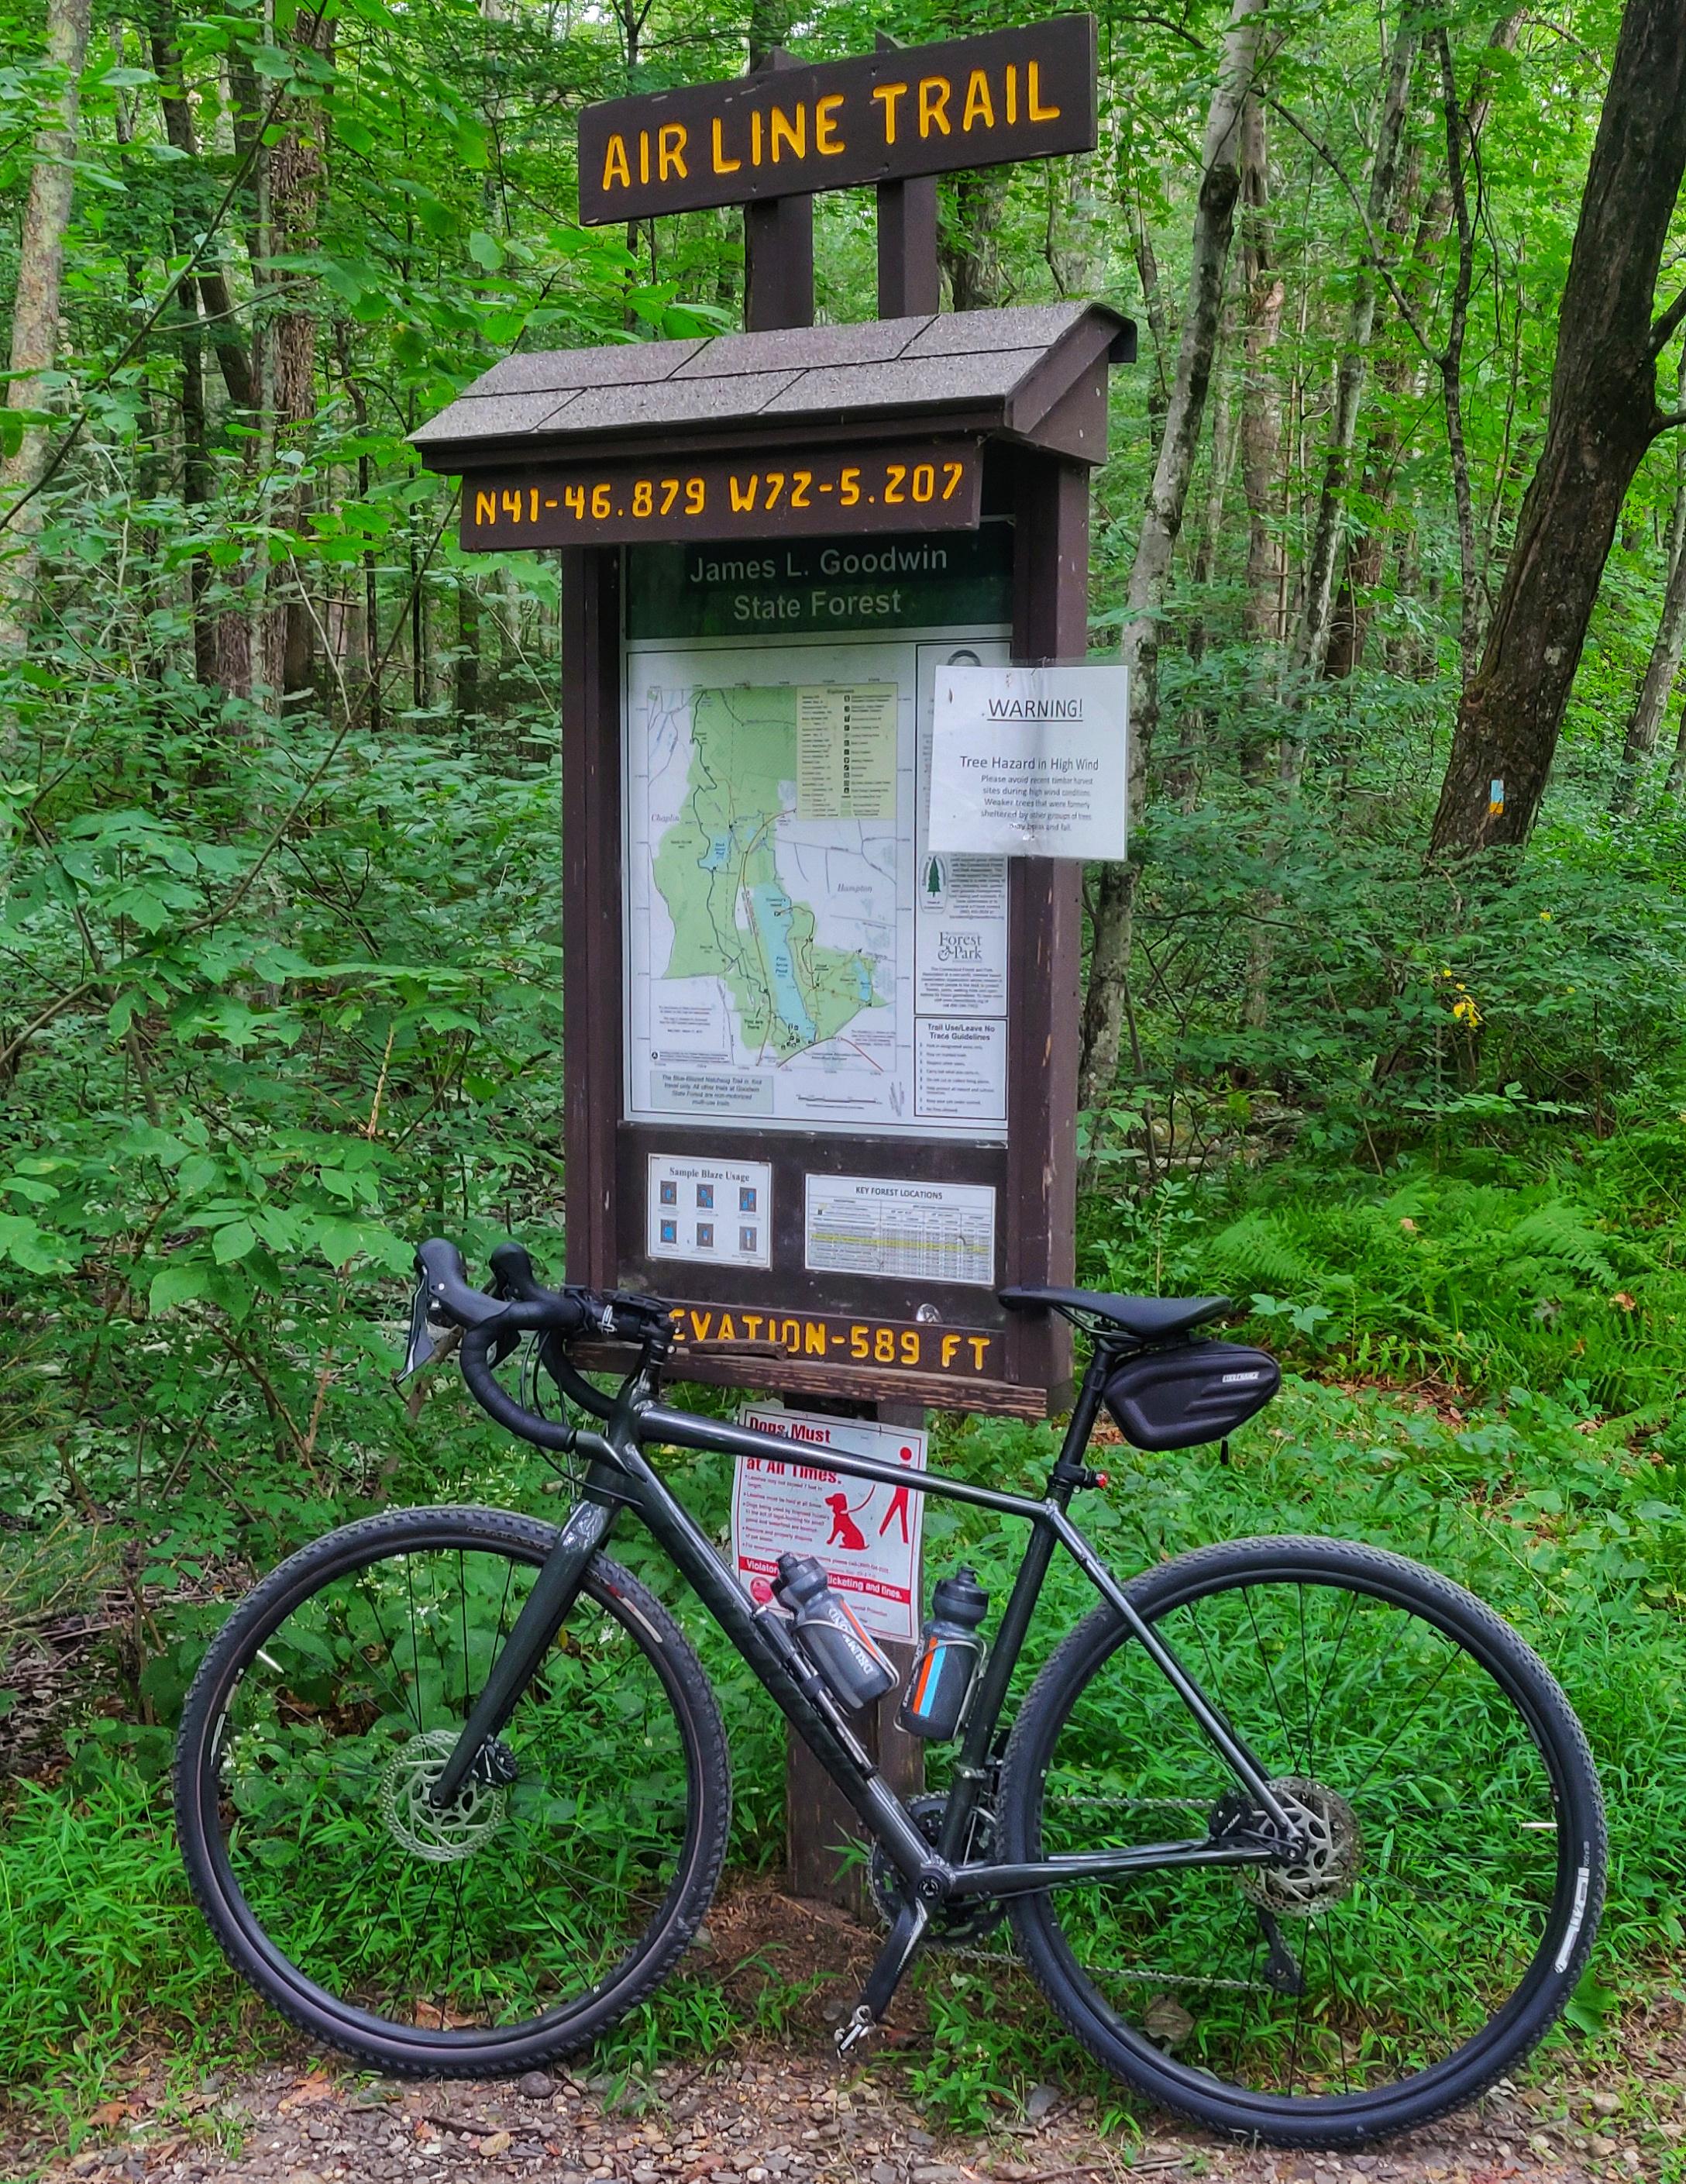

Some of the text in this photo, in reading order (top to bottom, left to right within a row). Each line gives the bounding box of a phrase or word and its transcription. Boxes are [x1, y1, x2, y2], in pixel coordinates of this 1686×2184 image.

[601, 60, 1061, 191] AIR LINE TRAIL
[475, 462, 964, 526] N41-46.879 W72-5.207
[690, 543, 948, 583] James L. Goodwin
[733, 589, 902, 621] State Forest
[988, 698, 1083, 718] WARNING!
[960, 756, 1099, 773] Tree Hazard in High Wind
[1008, 775, 1028, 784] avoid
[1003, 787, 1027, 797] during
[1029, 787, 1042, 797] high
[984, 797, 1013, 806] Weaker
[981, 809, 1017, 818] sheltered
[1019, 811, 1028, 821] by
[939, 932, 982, 946] Forest
[954, 945, 982, 960] Park
[945, 1023, 983, 1032] Use/Leave
[930, 1032, 990, 1041] Trace Guidelines
[669, 1167, 750, 1183] Sample Blaze Usage
[871, 1187, 899, 1197] FOREST
[900, 1188, 943, 1200] LOCATIONS
[941, 1334, 991, 1369] FT
[791, 1423, 831, 1444] Must
[746, 1458, 761, 1472] at
[766, 1461, 785, 1476] All
[865, 1583, 880, 1593] and
